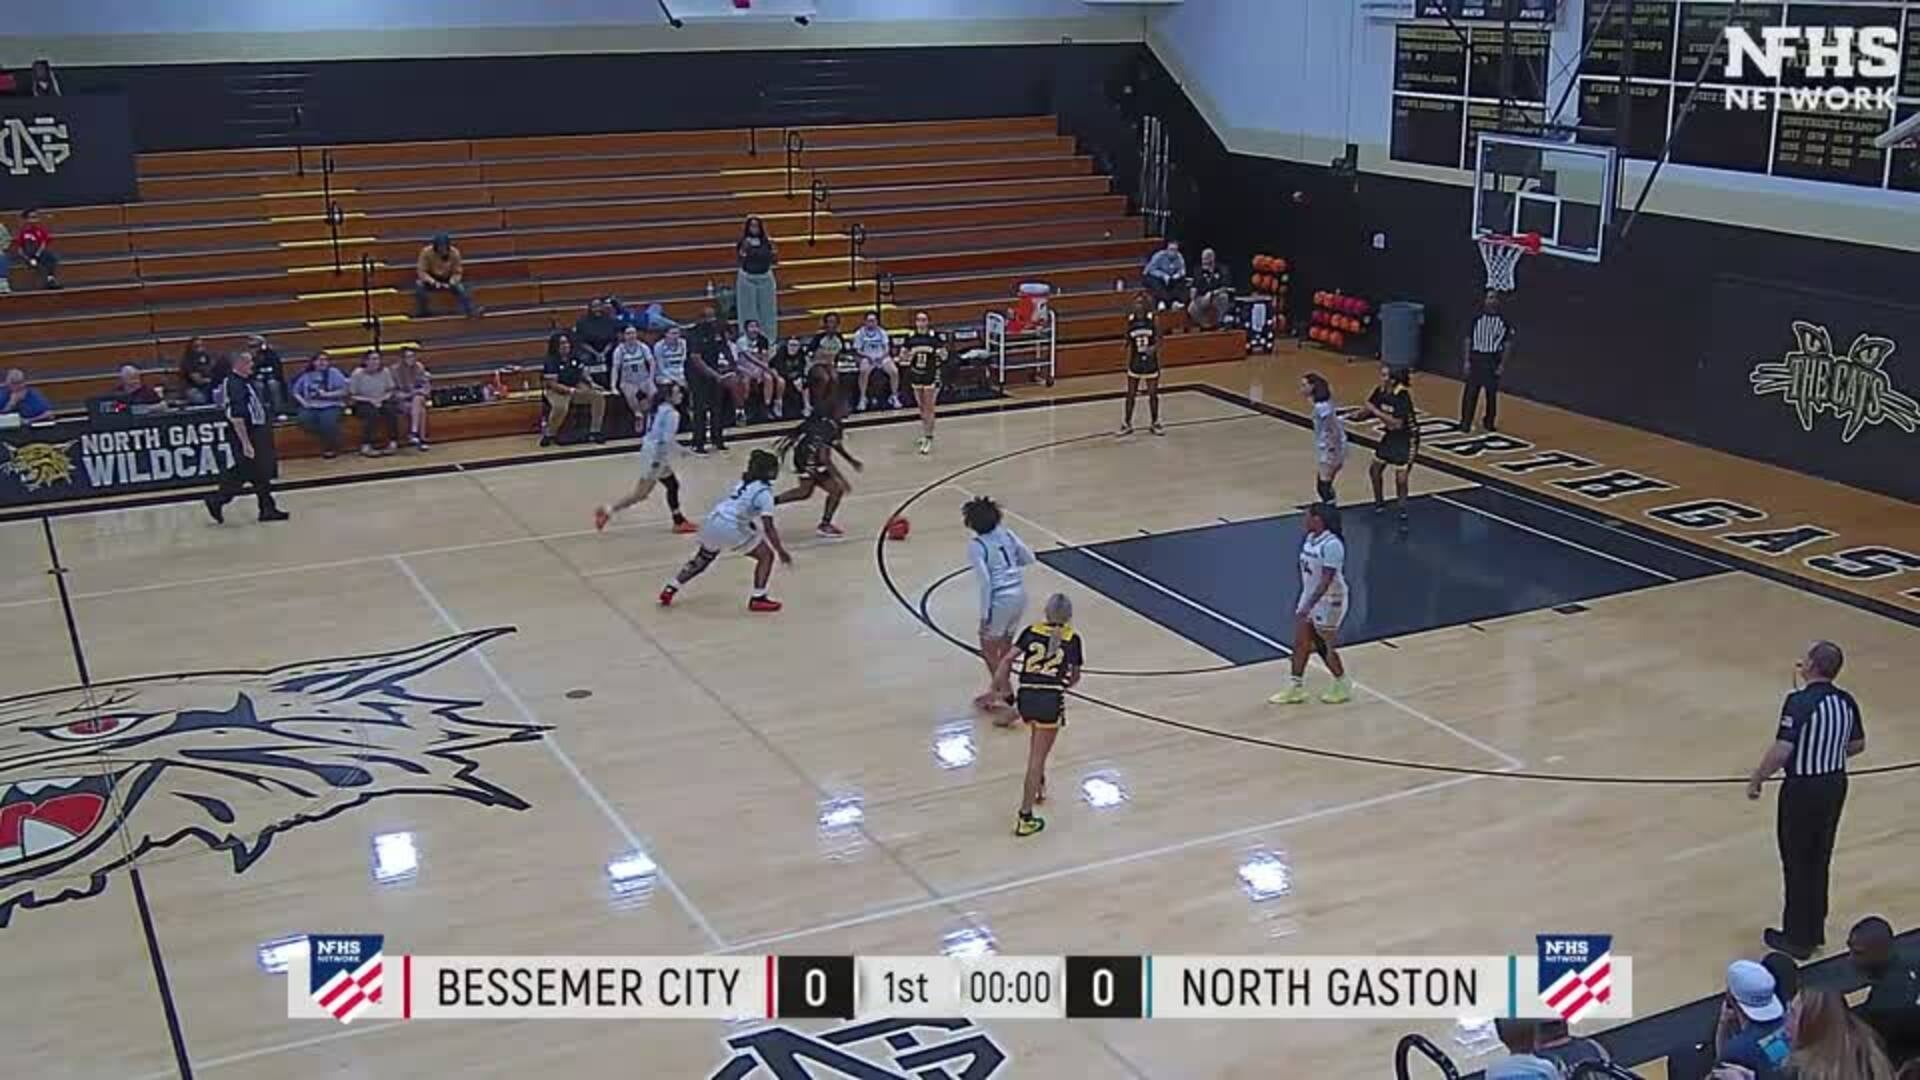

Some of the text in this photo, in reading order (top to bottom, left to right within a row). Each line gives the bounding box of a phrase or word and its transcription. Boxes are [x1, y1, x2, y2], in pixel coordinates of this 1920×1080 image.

[1833, 364, 1885, 418] CATS
[81, 422, 228, 455] NORTH GAST
[1000, 546, 1012, 567] 1
[1644, 498, 1920, 602] GAS
[1025, 641, 1065, 674] 22
